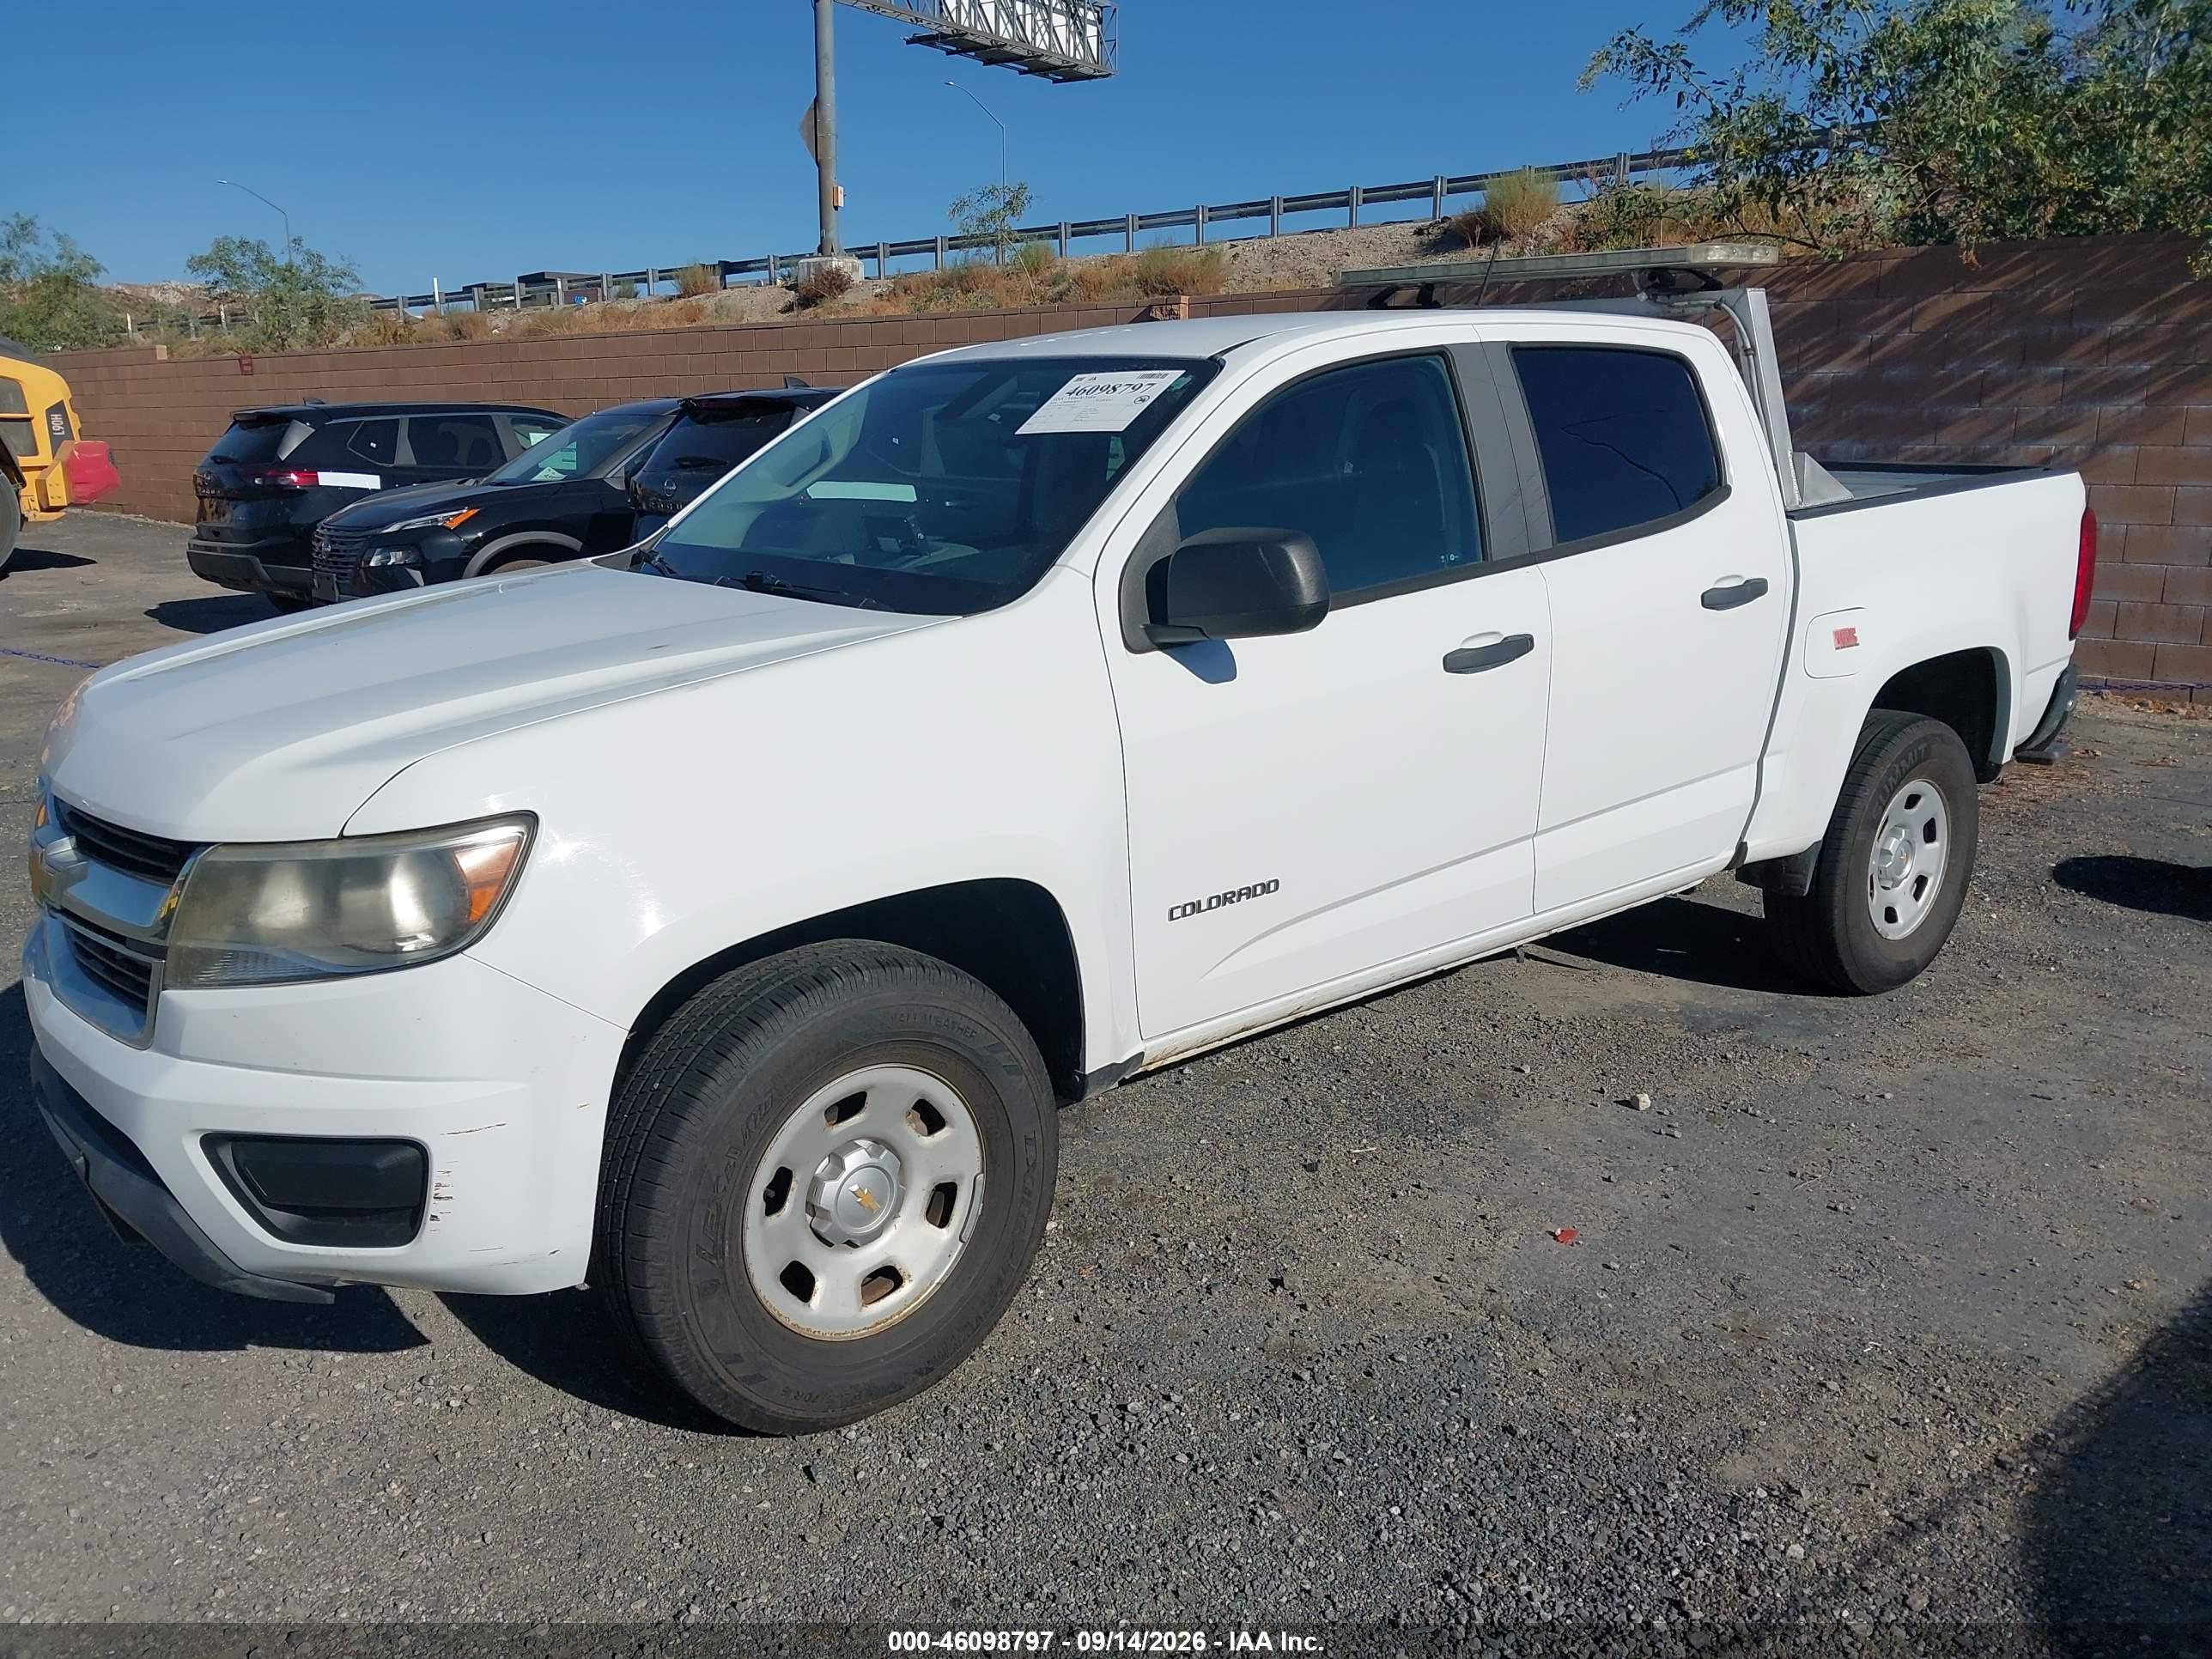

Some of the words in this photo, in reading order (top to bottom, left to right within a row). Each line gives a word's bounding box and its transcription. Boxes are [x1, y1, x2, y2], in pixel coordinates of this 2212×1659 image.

[1066, 383, 1155, 396] 46098797
[51, 414, 65, 435] L90H
[651, 501, 684, 510] ROGU
[1168, 878, 1279, 921] COLORADO
